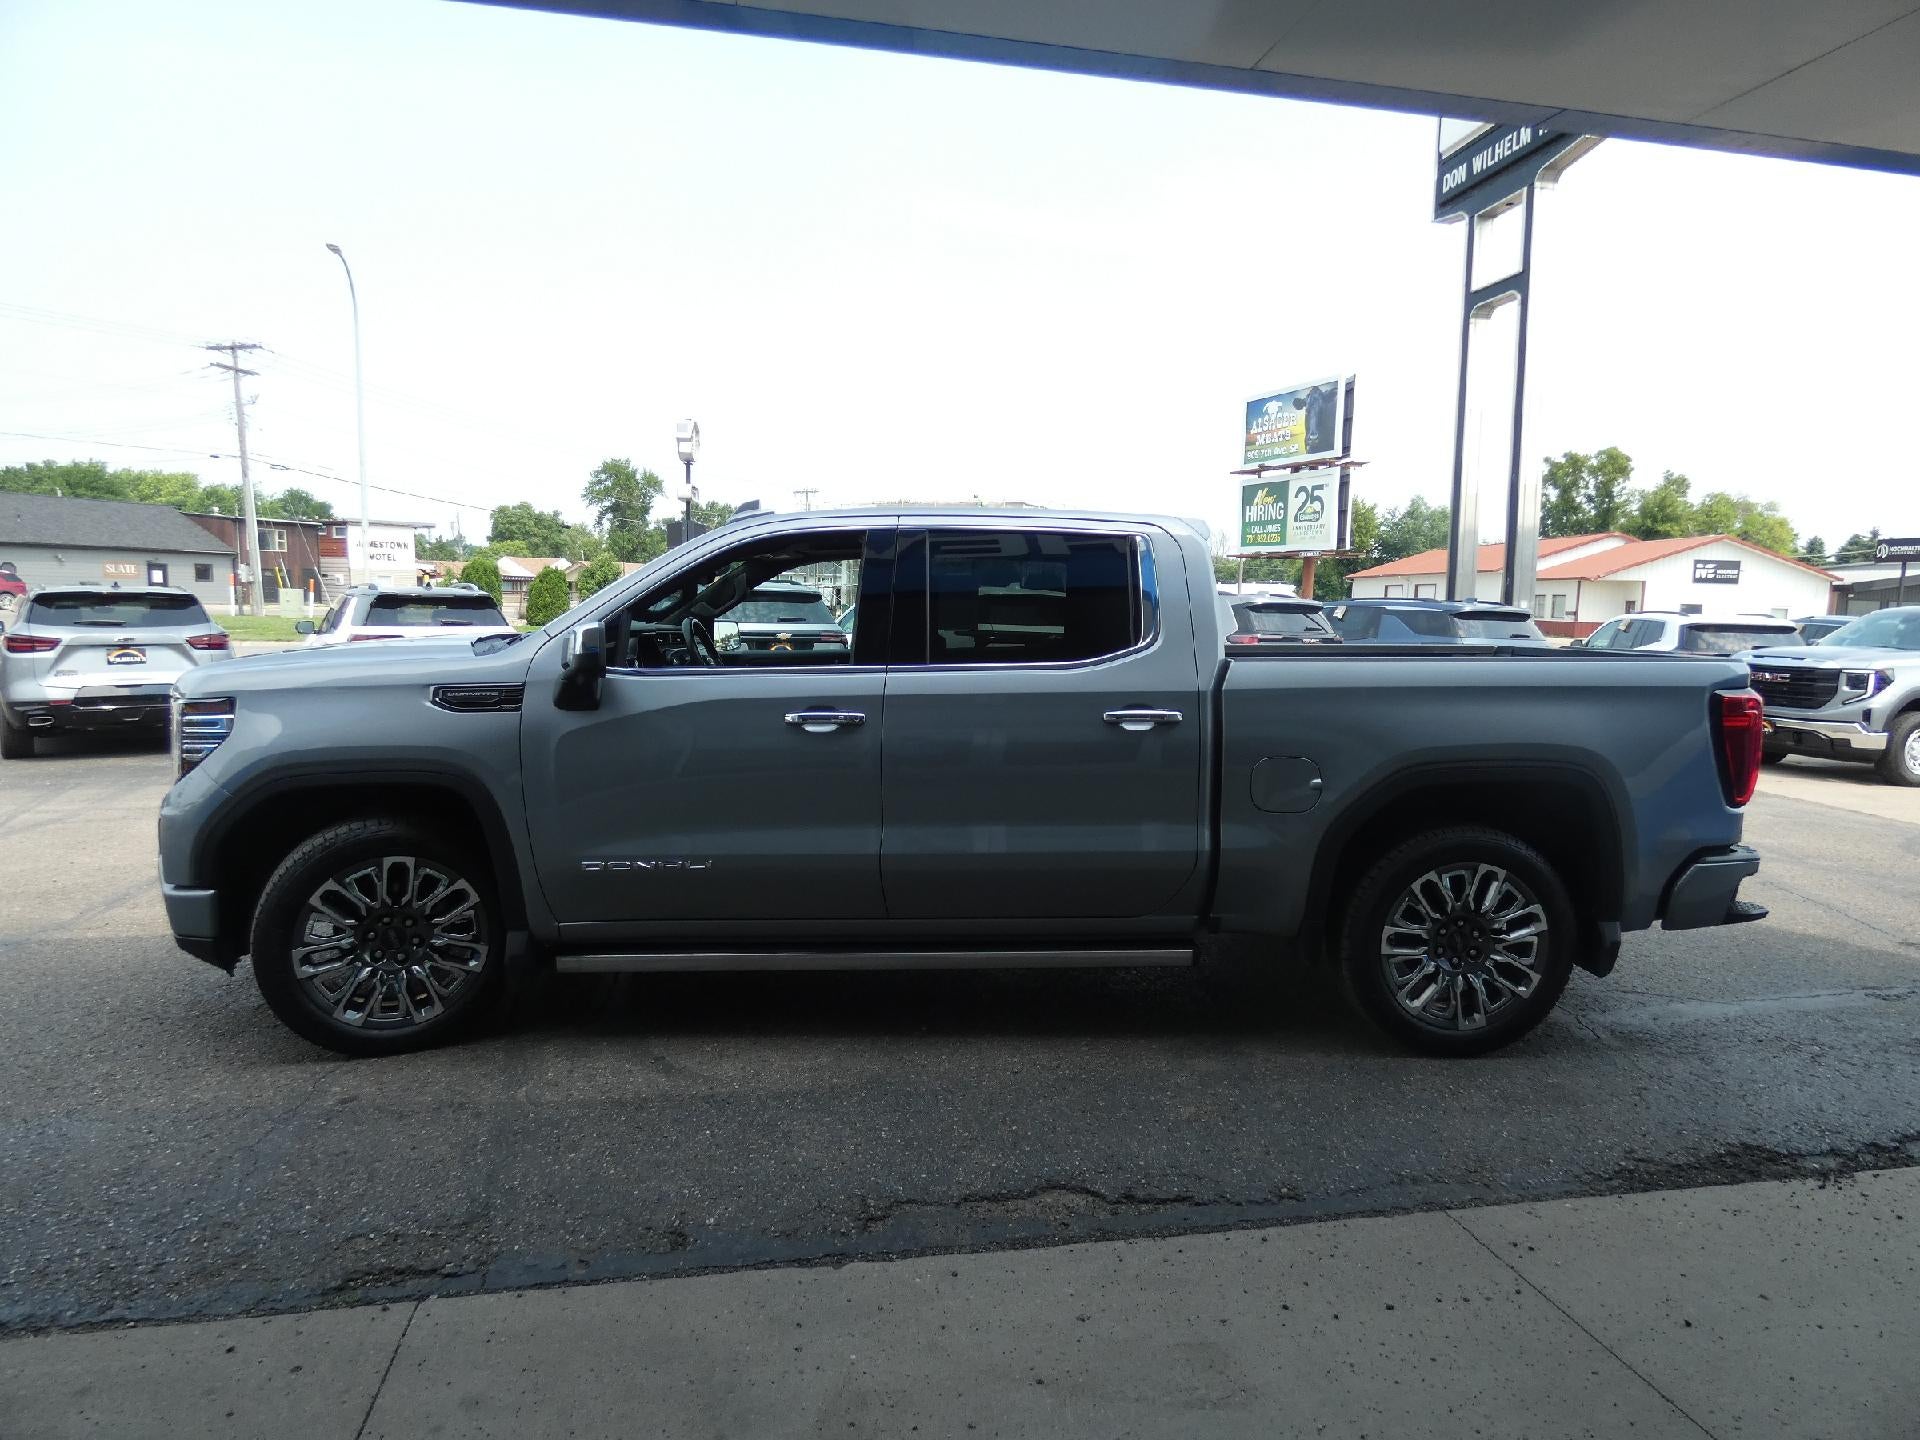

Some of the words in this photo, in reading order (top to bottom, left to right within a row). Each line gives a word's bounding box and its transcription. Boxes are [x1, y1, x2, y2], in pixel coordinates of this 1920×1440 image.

[1442, 162, 1467, 194] DON
[1472, 126, 1531, 174] WILHELM
[1294, 484, 1325, 522] 25
[1245, 502, 1284, 522] HIRING
[1252, 525, 1264, 534] CALL
[370, 553, 396, 561] MOTEL
[105, 564, 137, 573] SLATE
